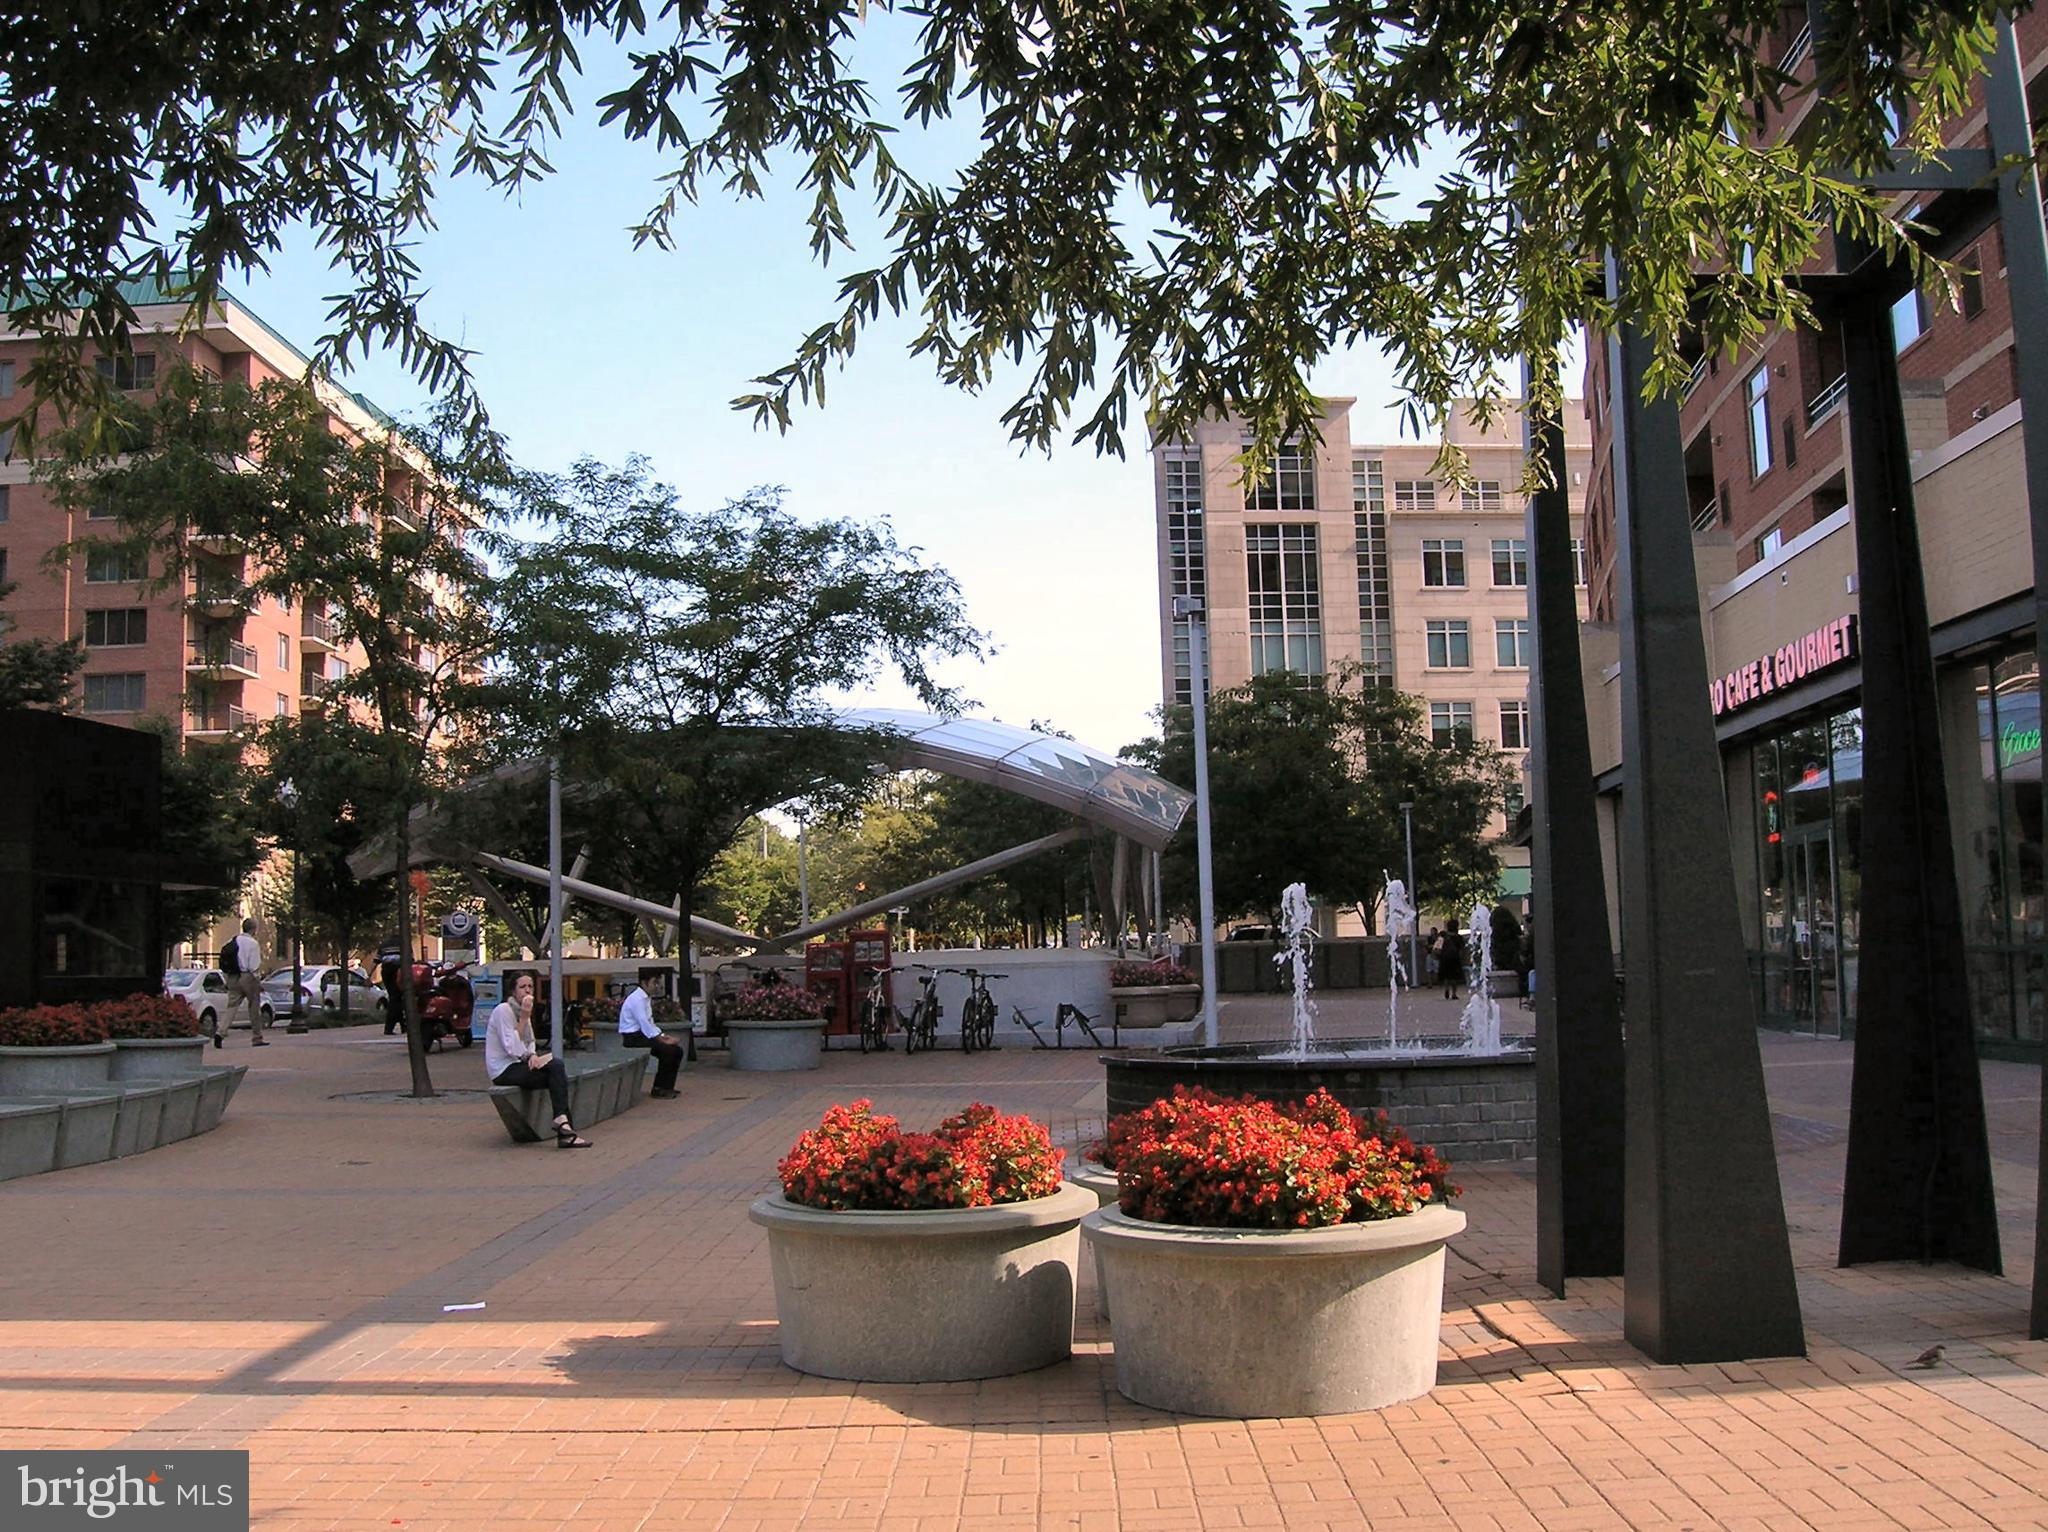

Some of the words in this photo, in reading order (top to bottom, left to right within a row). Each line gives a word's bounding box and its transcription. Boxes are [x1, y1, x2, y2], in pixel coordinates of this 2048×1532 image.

[1725, 660, 1760, 709] CAFE
[1761, 655, 1773, 694] &
[1775, 615, 1850, 687] GOURMET
